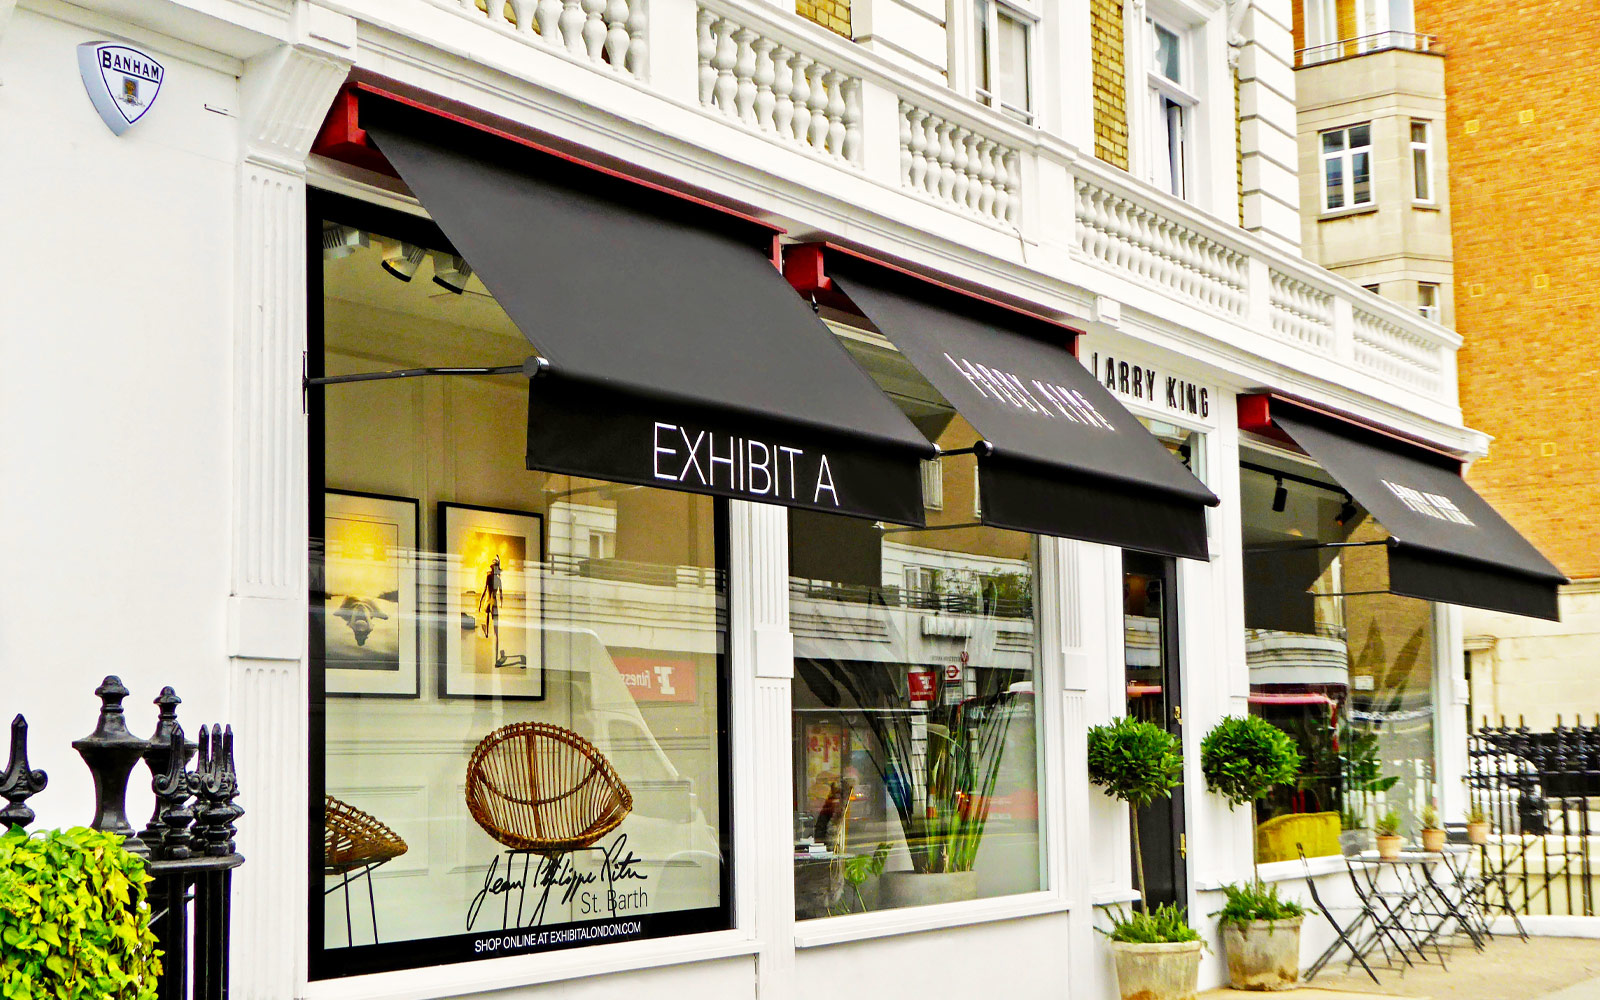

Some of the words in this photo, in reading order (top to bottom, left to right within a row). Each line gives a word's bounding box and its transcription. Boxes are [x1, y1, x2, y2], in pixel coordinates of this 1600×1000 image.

[102, 50, 159, 80] BANHAM
[1092, 352, 1156, 402] LARRY
[1166, 376, 1209, 418] KING
[653, 421, 803, 499] EXHIBIT
[814, 454, 840, 507] A
[467, 854, 524, 931] Jean
[581, 891, 602, 914] St.
[607, 887, 648, 912] Barth
[474, 937, 502, 953] SHOP
[503, 933, 536, 949] ONLINE
[537, 933, 548, 945] AT
[550, 921, 641, 943] EXHIBITALONDON.COM
